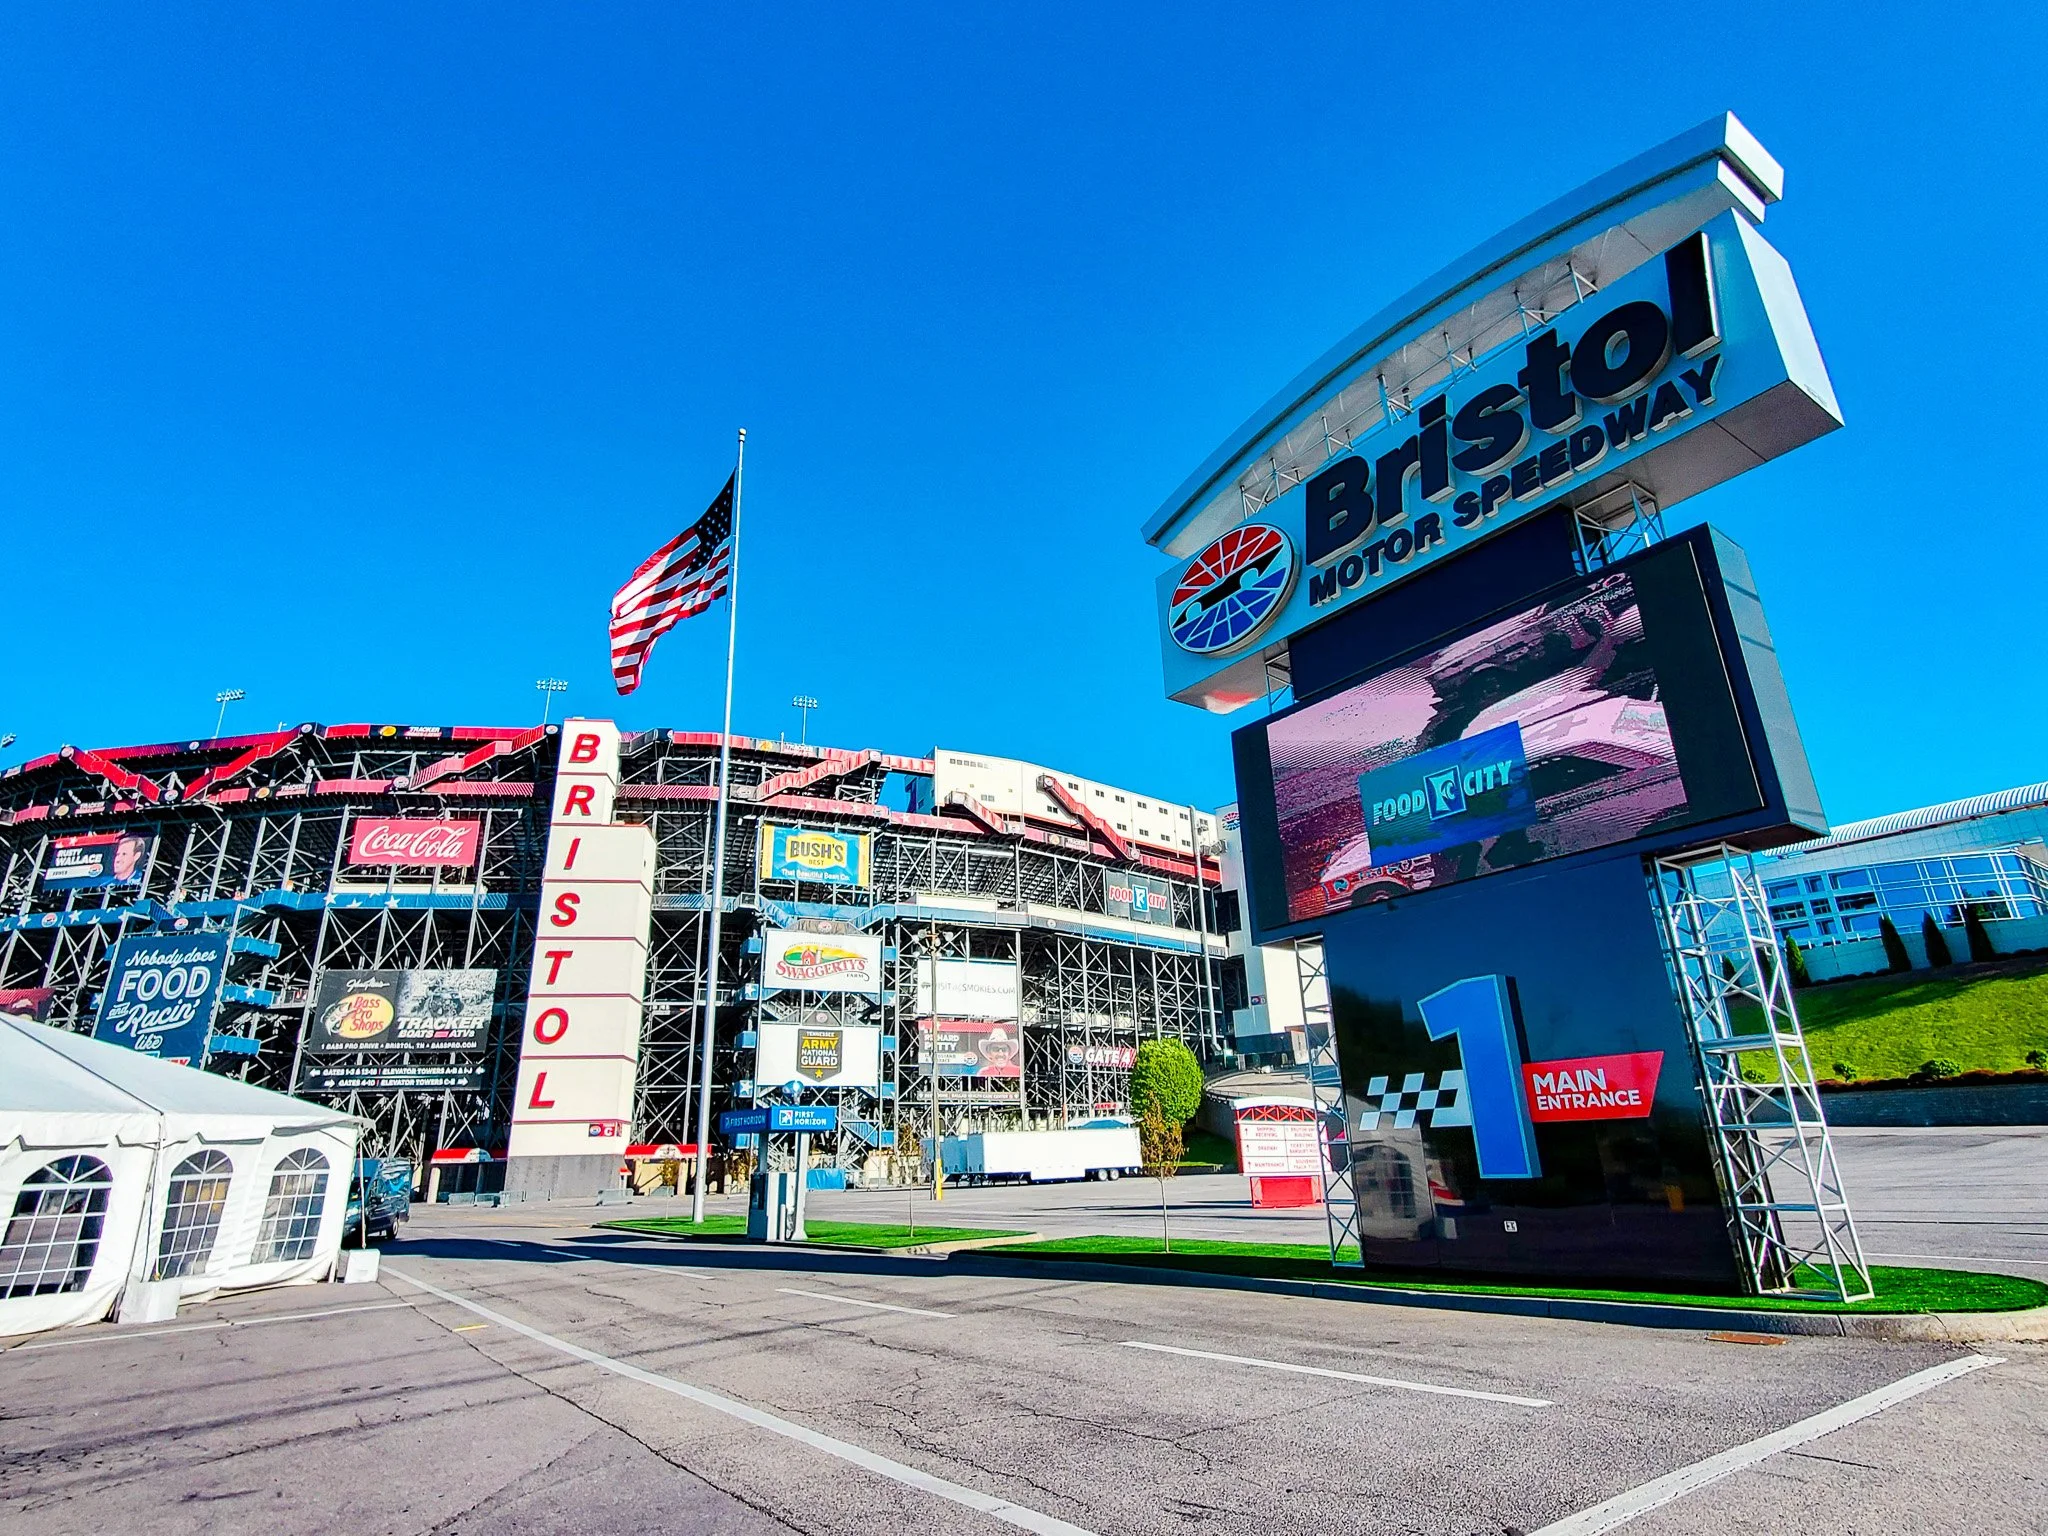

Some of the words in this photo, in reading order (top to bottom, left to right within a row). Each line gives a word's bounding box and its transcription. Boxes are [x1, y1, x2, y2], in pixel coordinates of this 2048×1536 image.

[1306, 231, 1718, 566] Bristol
[1309, 510, 1444, 607] MOTOR
[1451, 354, 1723, 527] SPEEDWAY
[1372, 789, 1425, 826] FOOD
[1465, 760, 1513, 797] CITY
[359, 825, 473, 858] Coca-Cola
[56, 854, 103, 866] WALLACE
[790, 841, 843, 862] BUSH'S
[1109, 886, 1133, 903] FOOD
[1148, 893, 1166, 909] CITY
[527, 733, 601, 1110] BRISTOL
[125, 948, 183, 968] Nobody
[184, 947, 217, 962] does
[117, 966, 211, 1001] FOOD
[354, 996, 381, 1008] Bass
[115, 999, 201, 1037] Racin'
[353, 1008, 372, 1020] Pro
[398, 1017, 485, 1030] TRACKER
[350, 1019, 384, 1032] Shops
[398, 1030, 434, 1038] BOATS
[134, 1034, 163, 1050] like
[802, 1040, 837, 1049] ARMY
[801, 1056, 837, 1066] GUARD
[1085, 1047, 1120, 1065] GATE
[382, 1068, 416, 1076] ELEVATOR
[1417, 974, 1538, 1178] 1
[1532, 1068, 1606, 1095] MAIN
[338, 1079, 361, 1087] GATES
[380, 1078, 415, 1086] ELEVATOR
[415, 1078, 443, 1086] TOWERS
[1536, 1089, 1642, 1111] ENTRANCE
[730, 1118, 742, 1126] FIRST
[744, 1115, 766, 1125] HORIZON
